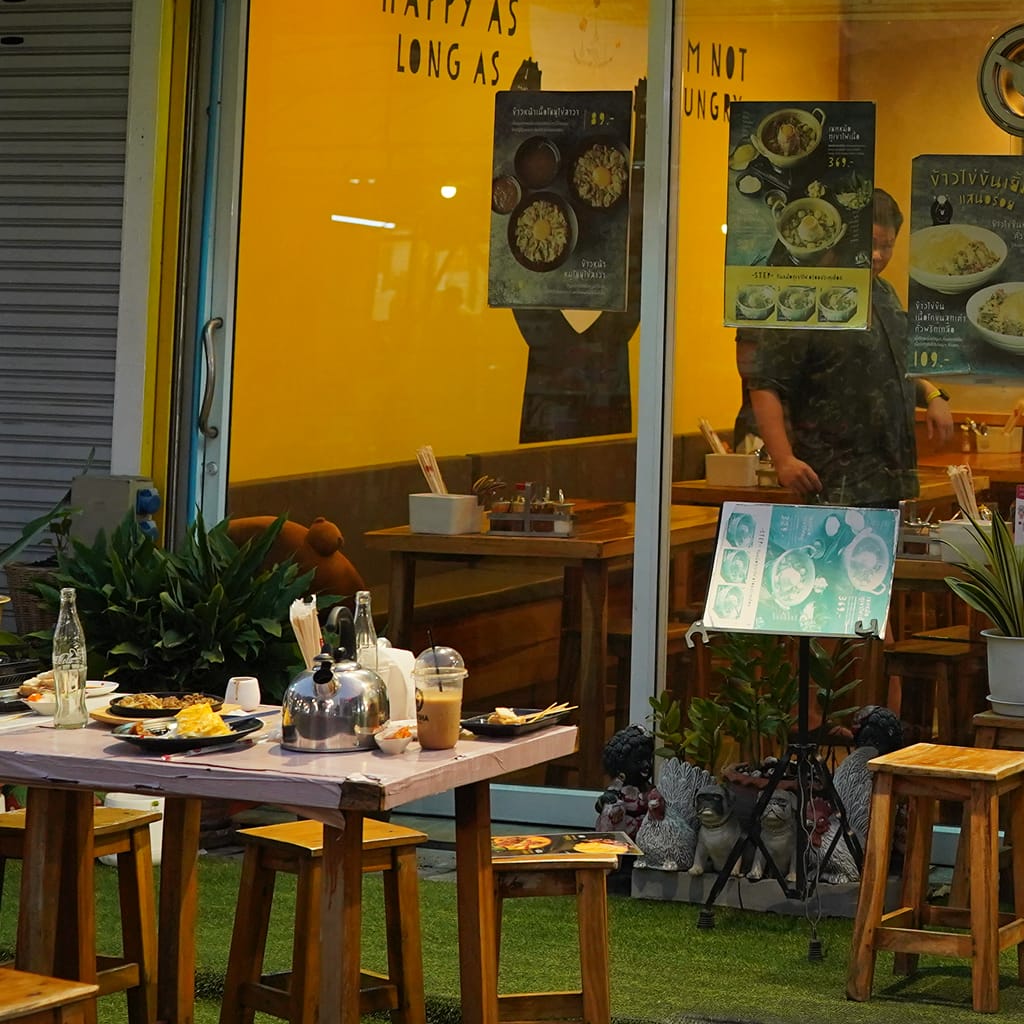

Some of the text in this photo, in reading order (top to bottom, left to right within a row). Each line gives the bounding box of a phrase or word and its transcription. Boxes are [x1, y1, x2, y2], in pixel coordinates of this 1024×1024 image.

[396, 33, 500, 87] LONG AS
[711, 42, 748, 83] NOT
[683, 87, 743, 123] UNGR
[913, 350, 950, 369] 109.-
